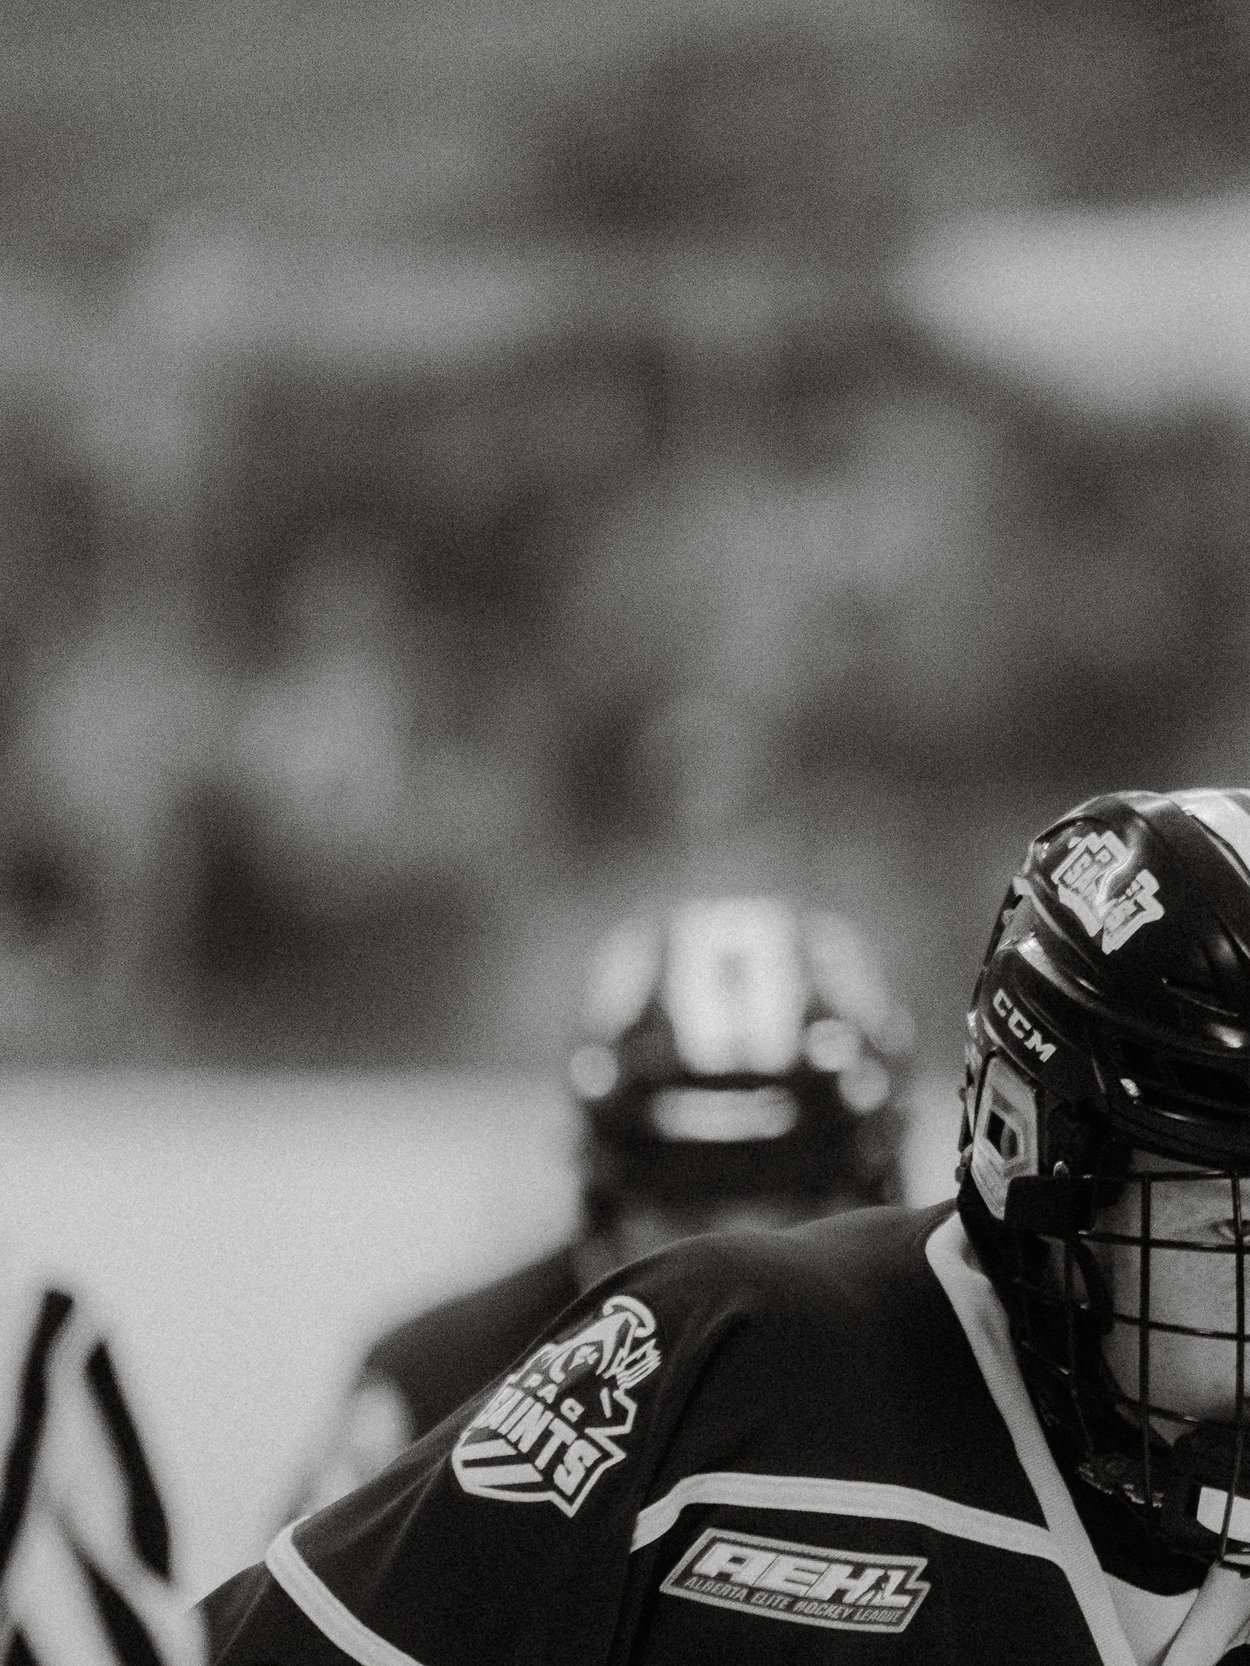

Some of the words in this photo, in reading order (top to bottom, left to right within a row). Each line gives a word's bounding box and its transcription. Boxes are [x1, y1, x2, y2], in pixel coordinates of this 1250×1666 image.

[992, 988, 1056, 1063] CCM
[683, 1575, 747, 1601] ALBERTA
[750, 1591, 790, 1611] ELITE
[793, 1598, 854, 1620] HOCKEY
[854, 1606, 905, 1625] LEAGUE
[691, 1541, 914, 1607] AEHL
